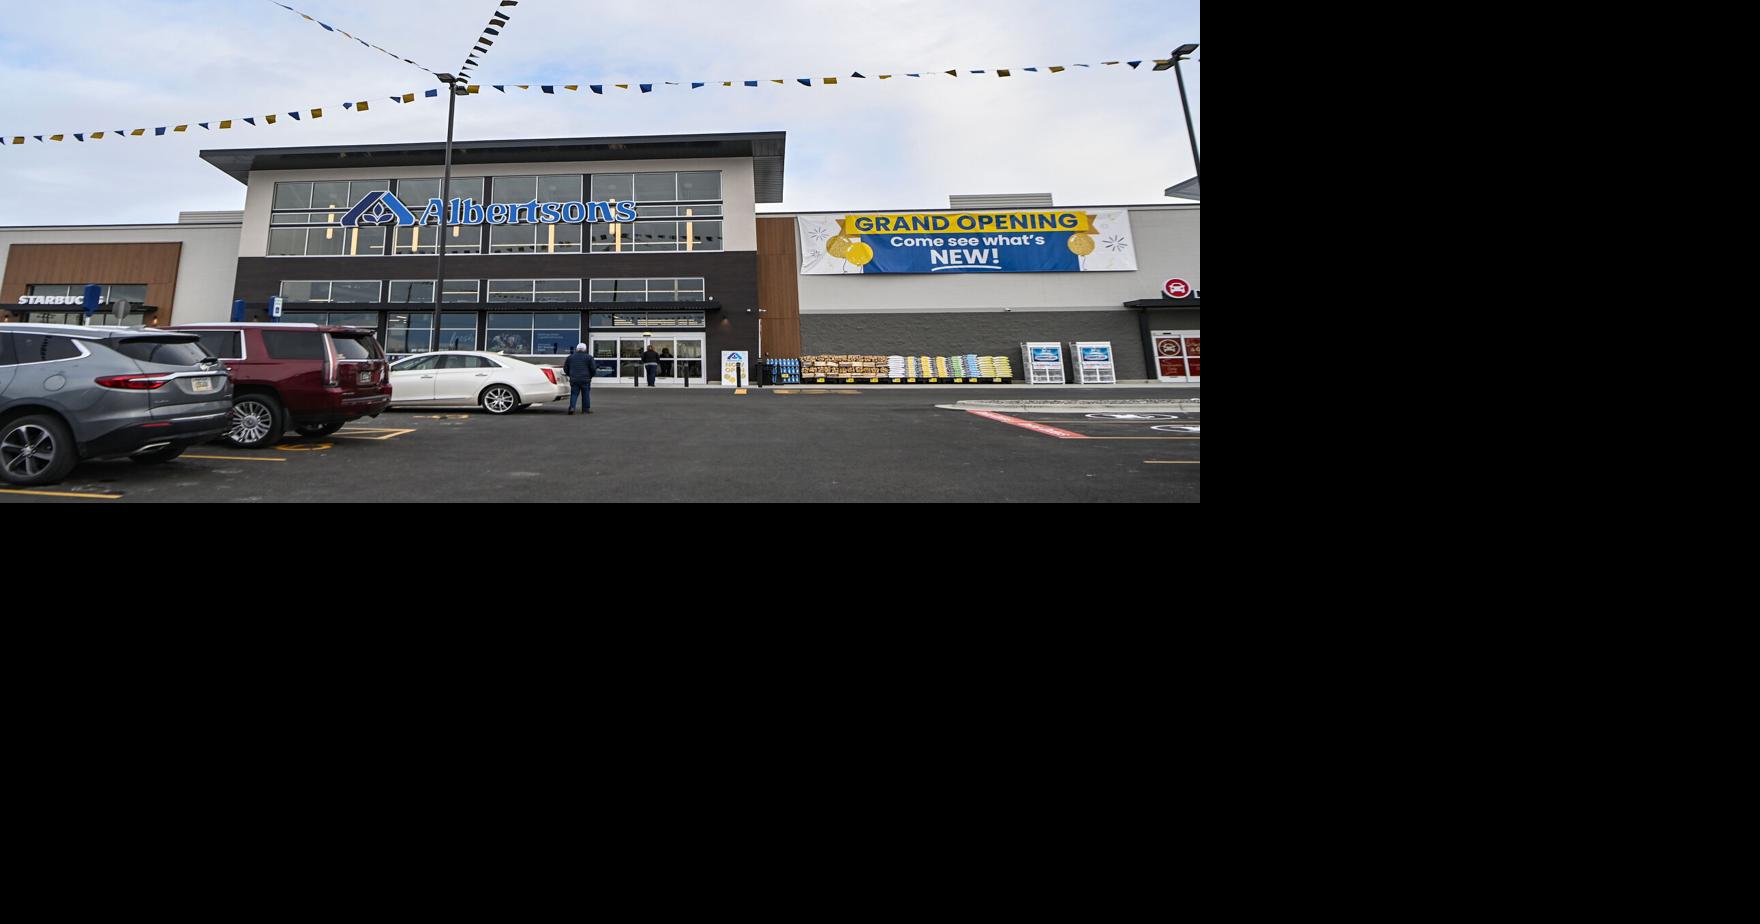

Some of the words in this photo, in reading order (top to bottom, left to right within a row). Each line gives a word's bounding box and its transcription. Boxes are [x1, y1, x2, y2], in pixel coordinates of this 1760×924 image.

[420, 197, 637, 225] Albertsons
[855, 214, 950, 232] GRAND
[957, 213, 1079, 231] OPENING
[890, 236, 945, 247] Come
[948, 237, 979, 247] see
[983, 234, 1045, 247] what's
[931, 248, 1000, 265] NEW!
[18, 295, 104, 304] STARBUCS
